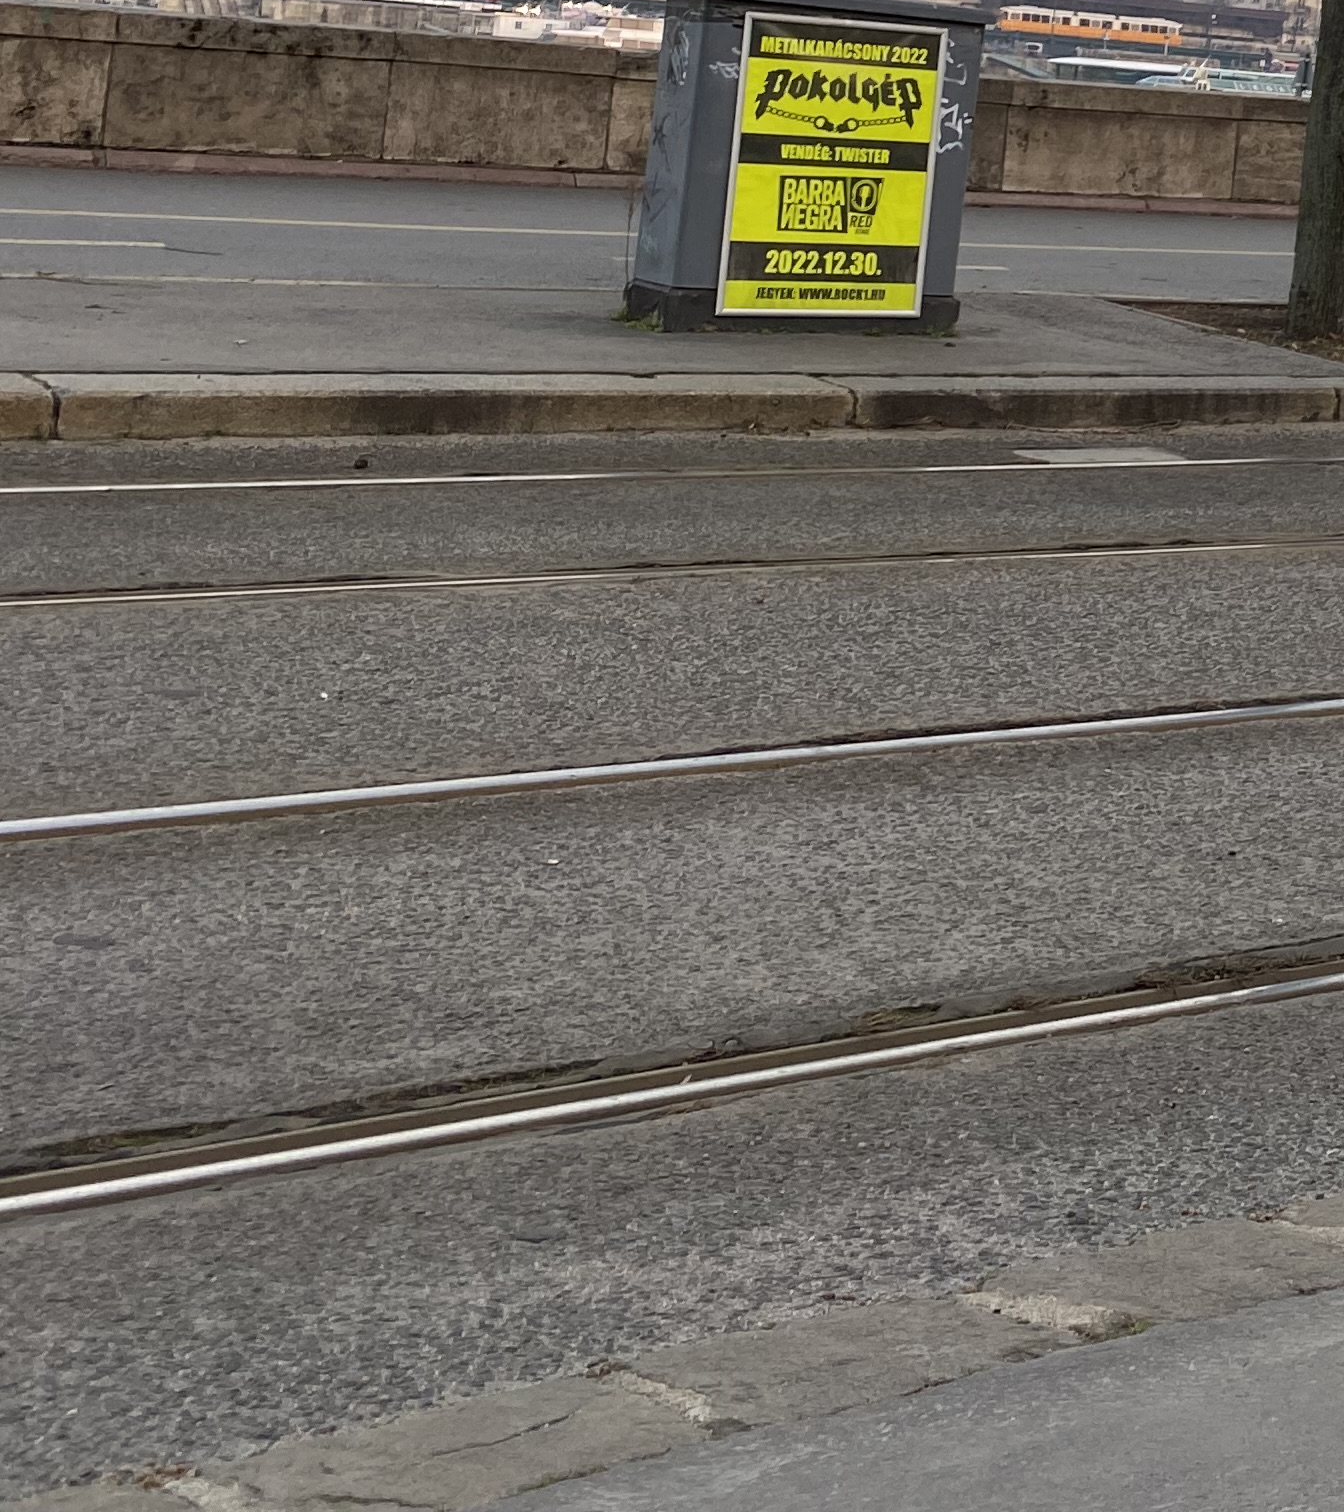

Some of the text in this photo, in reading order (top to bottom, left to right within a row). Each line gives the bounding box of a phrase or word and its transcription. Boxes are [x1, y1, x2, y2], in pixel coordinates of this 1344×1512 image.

[760, 36, 890, 61] METALKARÁCSONY
[891, 46, 928, 65] 2022
[781, 143, 890, 164] VENDÉG: TWISTER
[783, 178, 846, 206] BARBA
[780, 204, 843, 231] NEGRA
[849, 215, 873, 228] RED
[764, 249, 882, 276] 2022.12.30.
